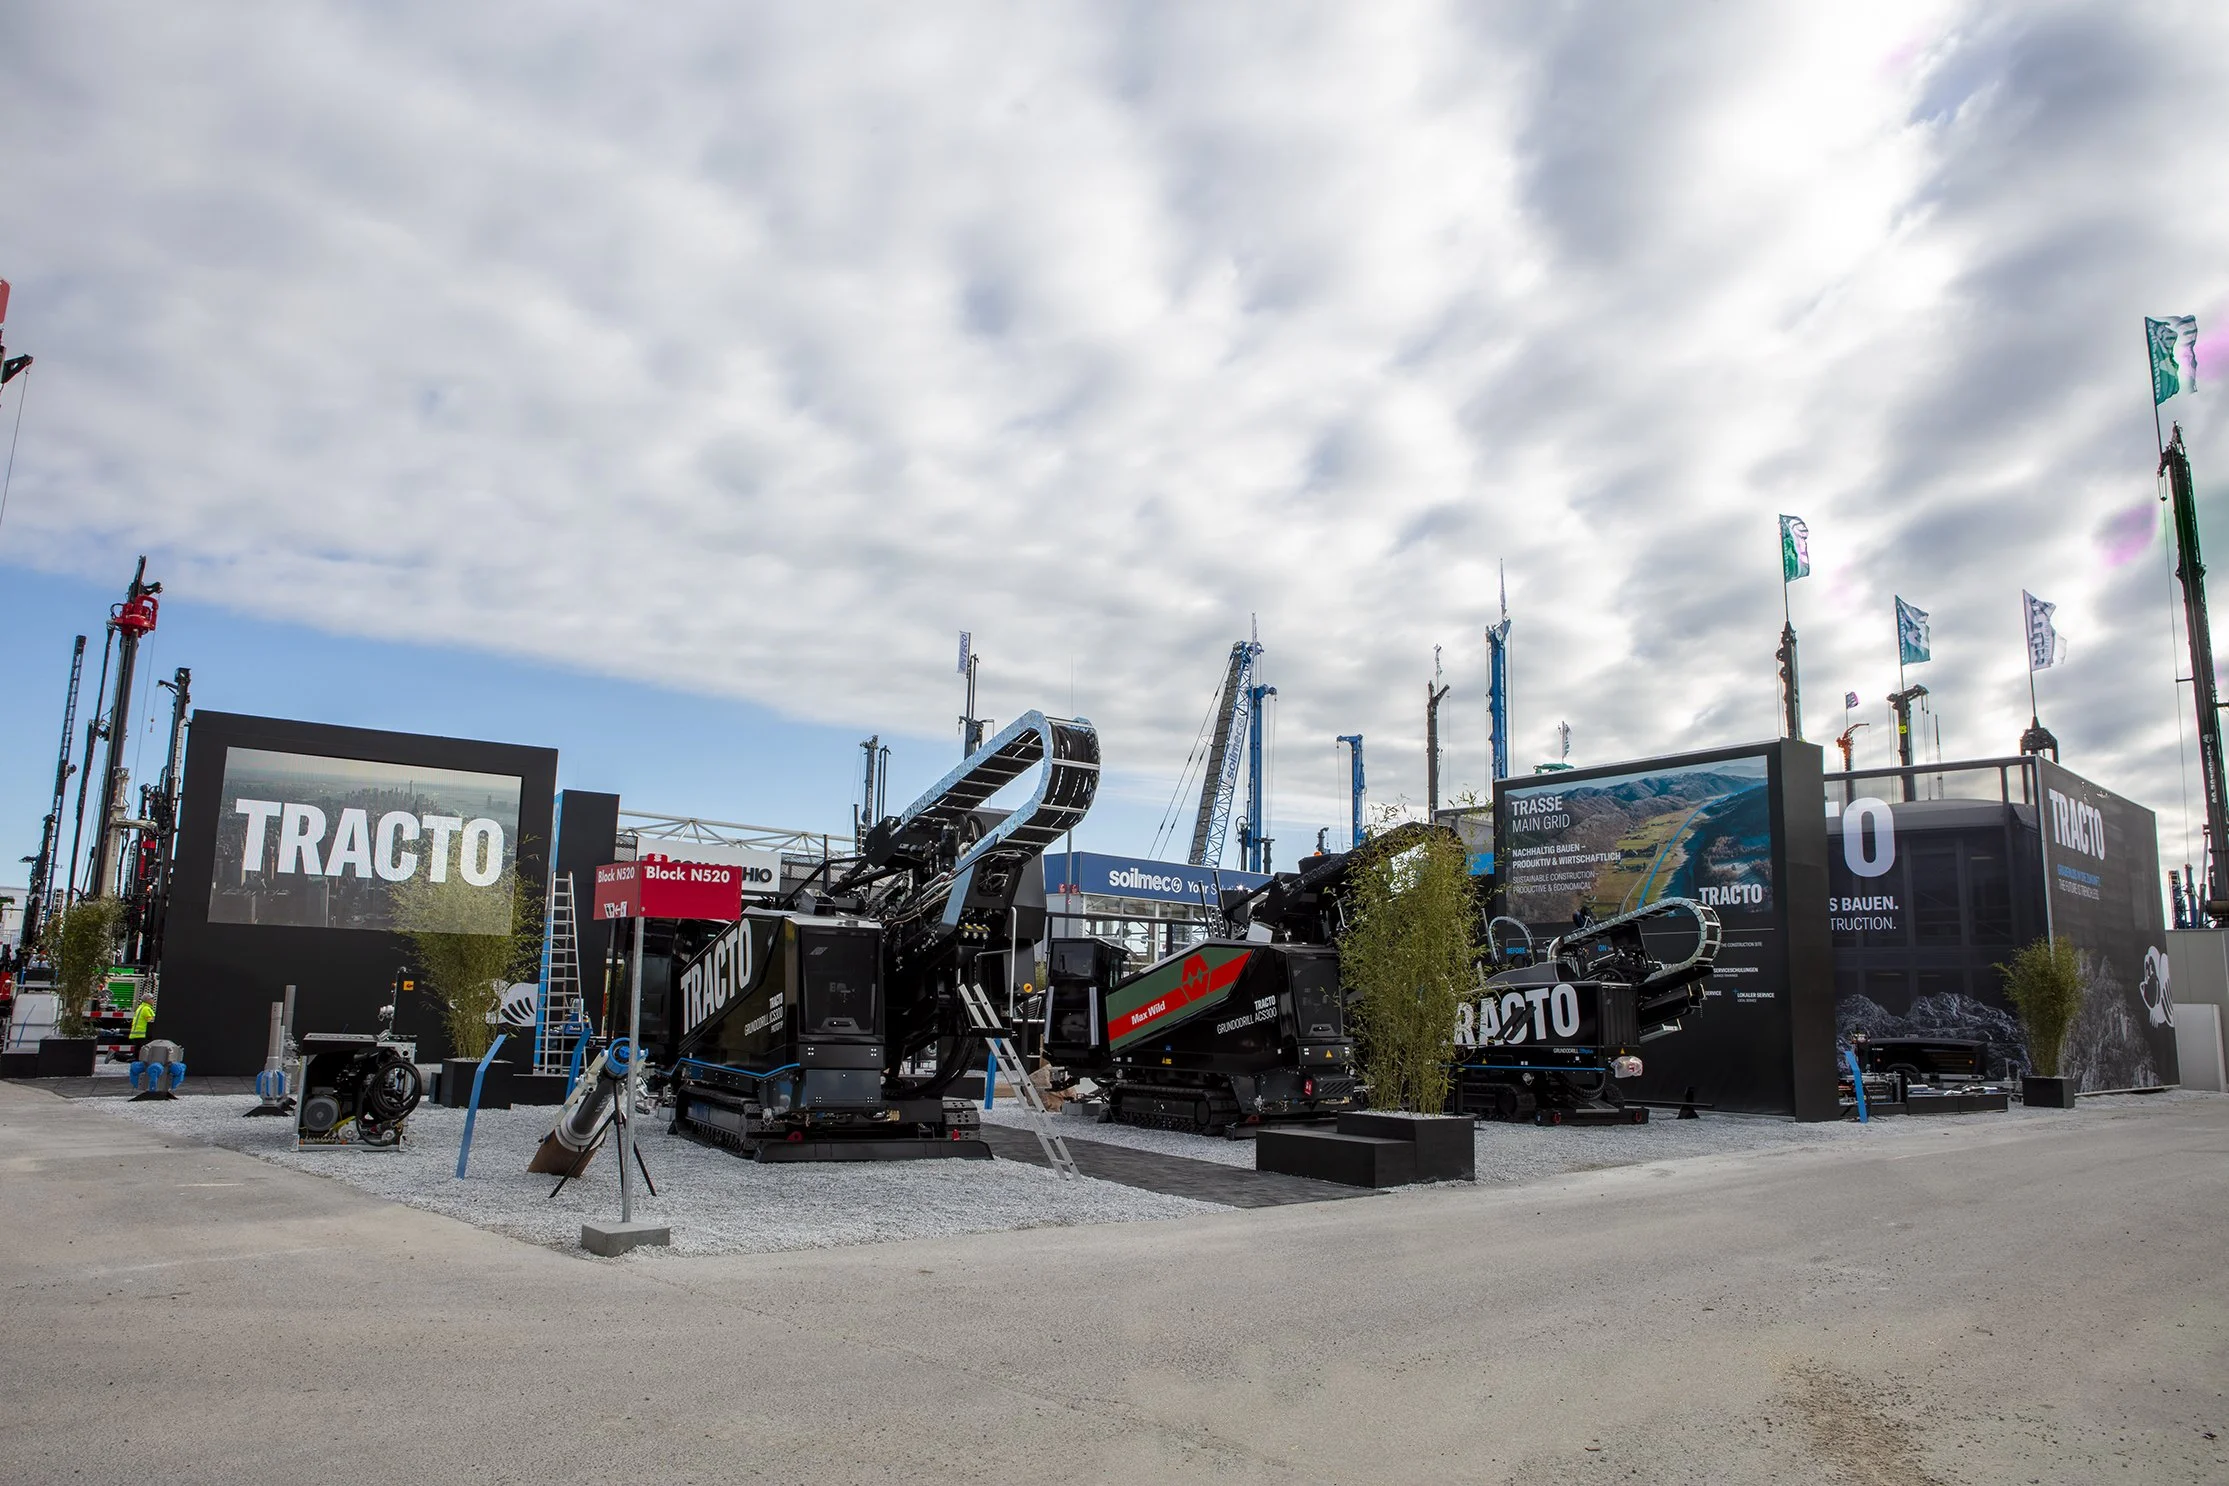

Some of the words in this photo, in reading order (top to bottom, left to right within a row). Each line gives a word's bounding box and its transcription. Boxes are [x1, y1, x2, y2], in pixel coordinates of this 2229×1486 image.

[1511, 796, 1563, 816] TRASSE
[1512, 817, 1540, 833] MAIN
[1543, 813, 1570, 830] GRID
[2048, 788, 2105, 861] TRACTO
[235, 798, 504, 887] TRACTO
[1512, 845, 1555, 857] NACHHALTIG
[1556, 843, 1580, 854] BAUEN
[1512, 857, 1551, 869] PRODUKTIV
[1552, 858, 1558, 866] &
[1559, 852, 1621, 865] WIRTSCHAFTLICH
[597, 868, 615, 883] Block
[616, 866, 636, 881] N520
[646, 866, 685, 881] Block
[690, 869, 730, 883] N520
[1512, 874, 1549, 885] SUSTAINABLE
[1549, 870, 1595, 882] CONSTRUCTION
[1187, 880, 1209, 895] Yor
[1553, 881, 1592, 892] ECONOMICAL
[1698, 883, 1762, 906] TRACTO
[1841, 895, 1899, 912] BAUEN.
[680, 917, 752, 1036] TRACTO
[1254, 995, 1276, 1011] TRACTO
[1131, 1008, 1147, 1025] Max
[1148, 1001, 1166, 1017] Wild
[1216, 1013, 1255, 1035] GRUNDODRILL
[1255, 1006, 1278, 1023] ACS300
